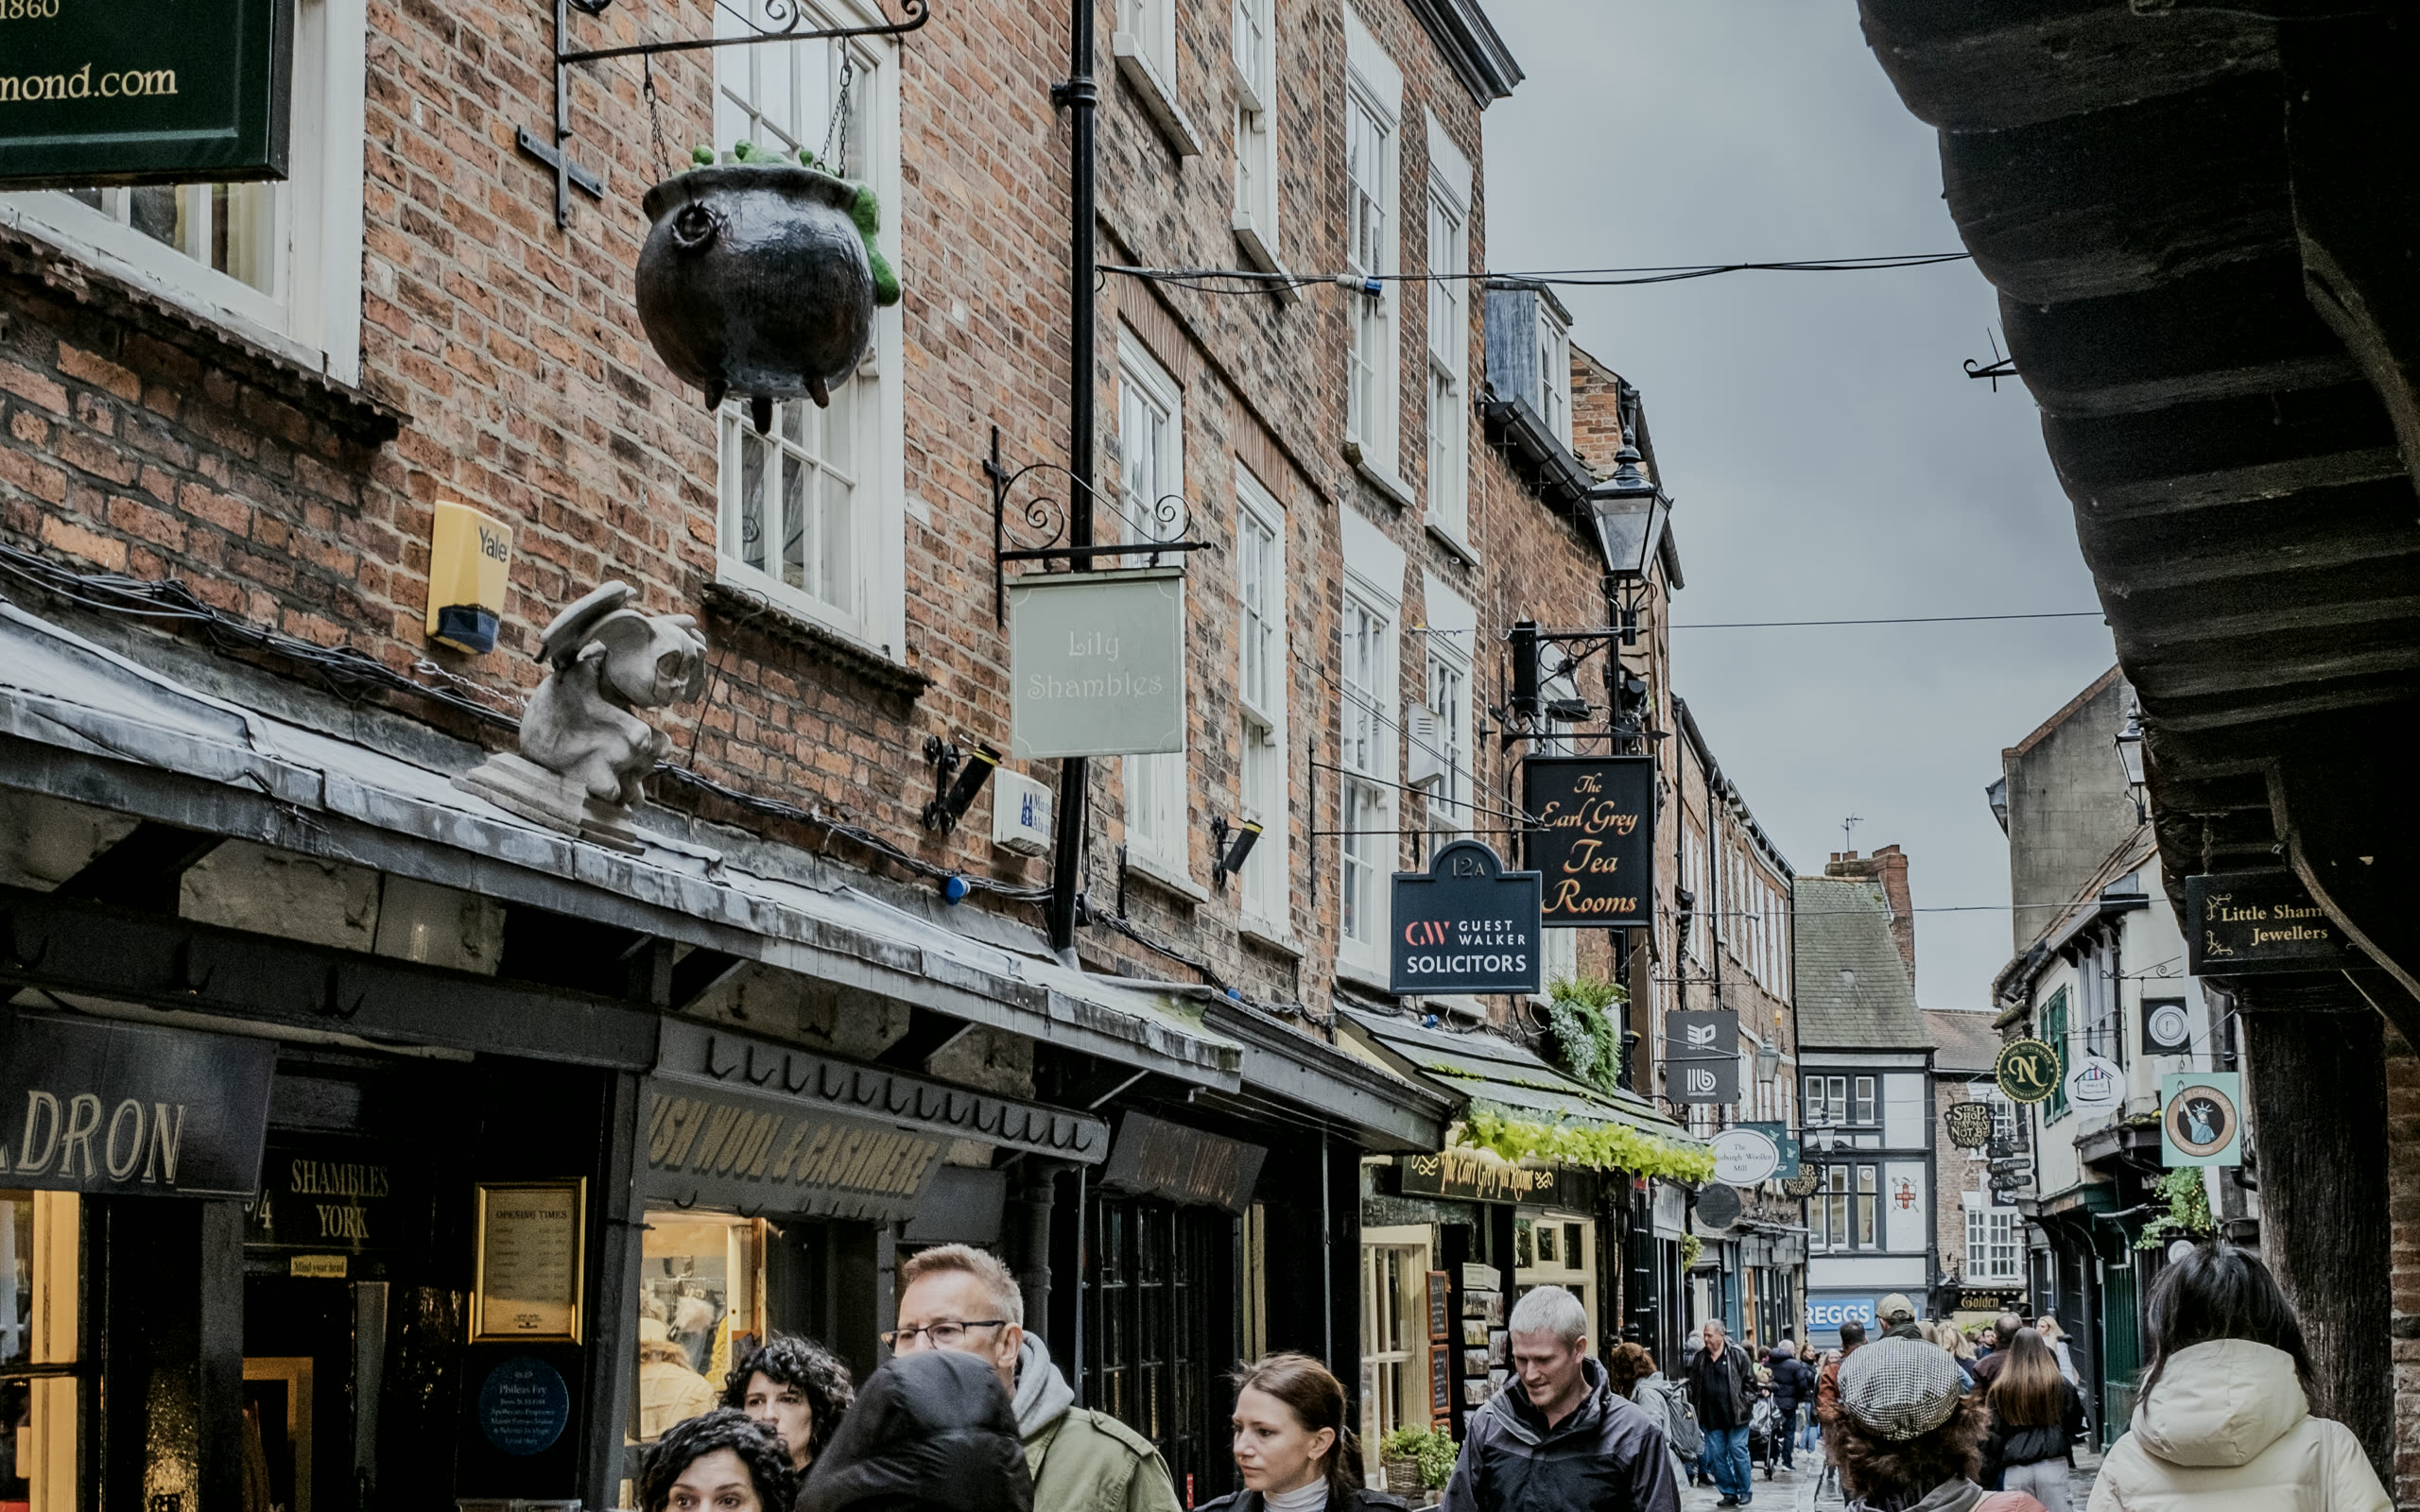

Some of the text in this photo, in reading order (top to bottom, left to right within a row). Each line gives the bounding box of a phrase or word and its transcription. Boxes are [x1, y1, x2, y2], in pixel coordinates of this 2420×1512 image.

[478, 525, 508, 563] Yale
[1068, 630, 1119, 662] Lily
[1028, 671, 1163, 699] Shambles
[1573, 772, 1602, 794] The
[1540, 798, 1638, 836] Earl Grey
[1563, 839, 1619, 874] Tea
[1452, 857, 1486, 877] 12A
[1542, 878, 1638, 914] Rooms
[2221, 904, 2328, 922] Little Sham
[1458, 919, 1512, 932] GUEST
[1459, 934, 1526, 946] WALKER
[2251, 926, 2328, 946] Jewellers
[1407, 954, 1527, 974] SOLICITORS
[2007, 1056, 2048, 1088] N
[1953, 1106, 1987, 1121] SHOP
[1951, 1126, 1973, 1139] NOT
[1957, 1137, 1985, 1145] NAMED
[648, 1091, 712, 1171] ISH
[692, 1104, 784, 1183] WOOL
[795, 1125, 942, 1199] CASHMERE
[1716, 1153, 1742, 1161] inburgh
[291, 1159, 389, 1197] SHAMBLES
[1441, 1150, 1457, 1194] The
[1457, 1152, 1478, 1186] Earl
[1477, 1157, 1497, 1198] Grey
[1510, 1163, 1533, 1202] Rooms
[316, 1204, 370, 1239] YORK
[495, 1210, 567, 1219] OPENING TIMES
[1961, 1296, 1999, 1309] Golden
[1806, 1305, 1870, 1325] REGGS
[532, 1383, 547, 1397] Fry
